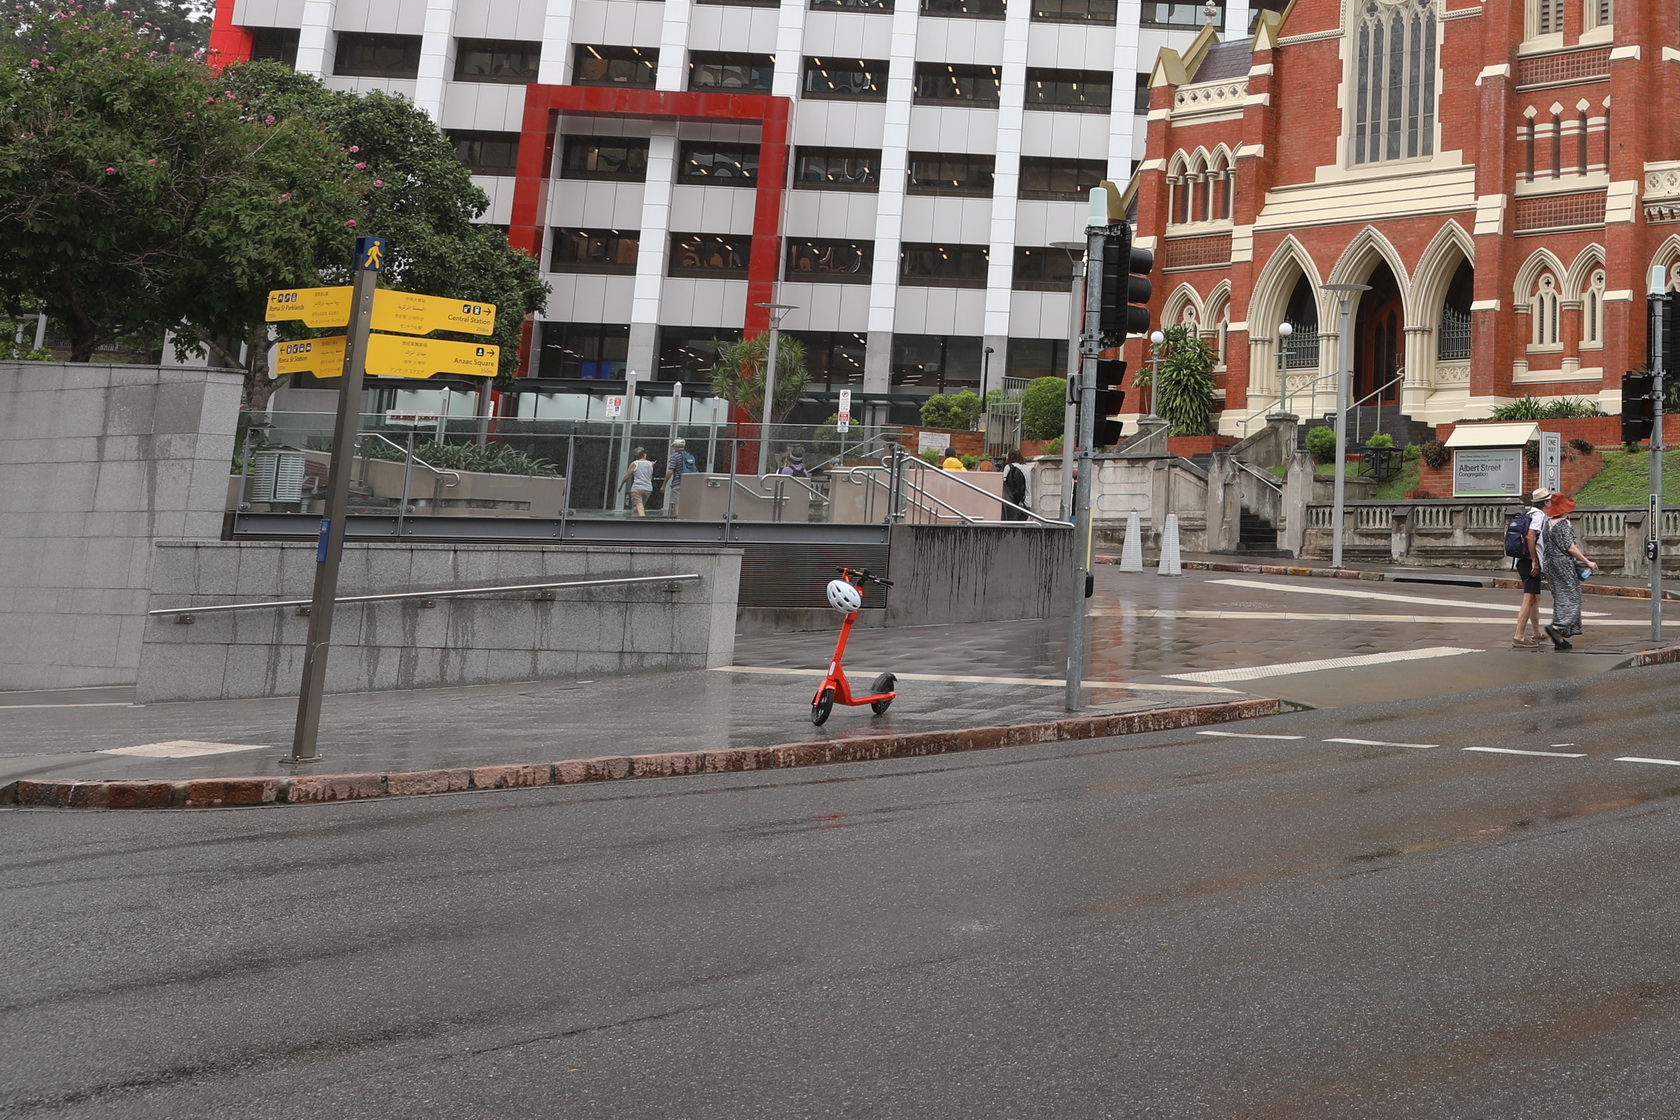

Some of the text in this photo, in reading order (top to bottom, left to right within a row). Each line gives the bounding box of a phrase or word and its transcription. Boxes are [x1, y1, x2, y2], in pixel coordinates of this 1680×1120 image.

[447, 313, 491, 326] Central Station
[453, 357, 495, 367] Anzac Square
[1459, 463, 1501, 472] Albert Street
